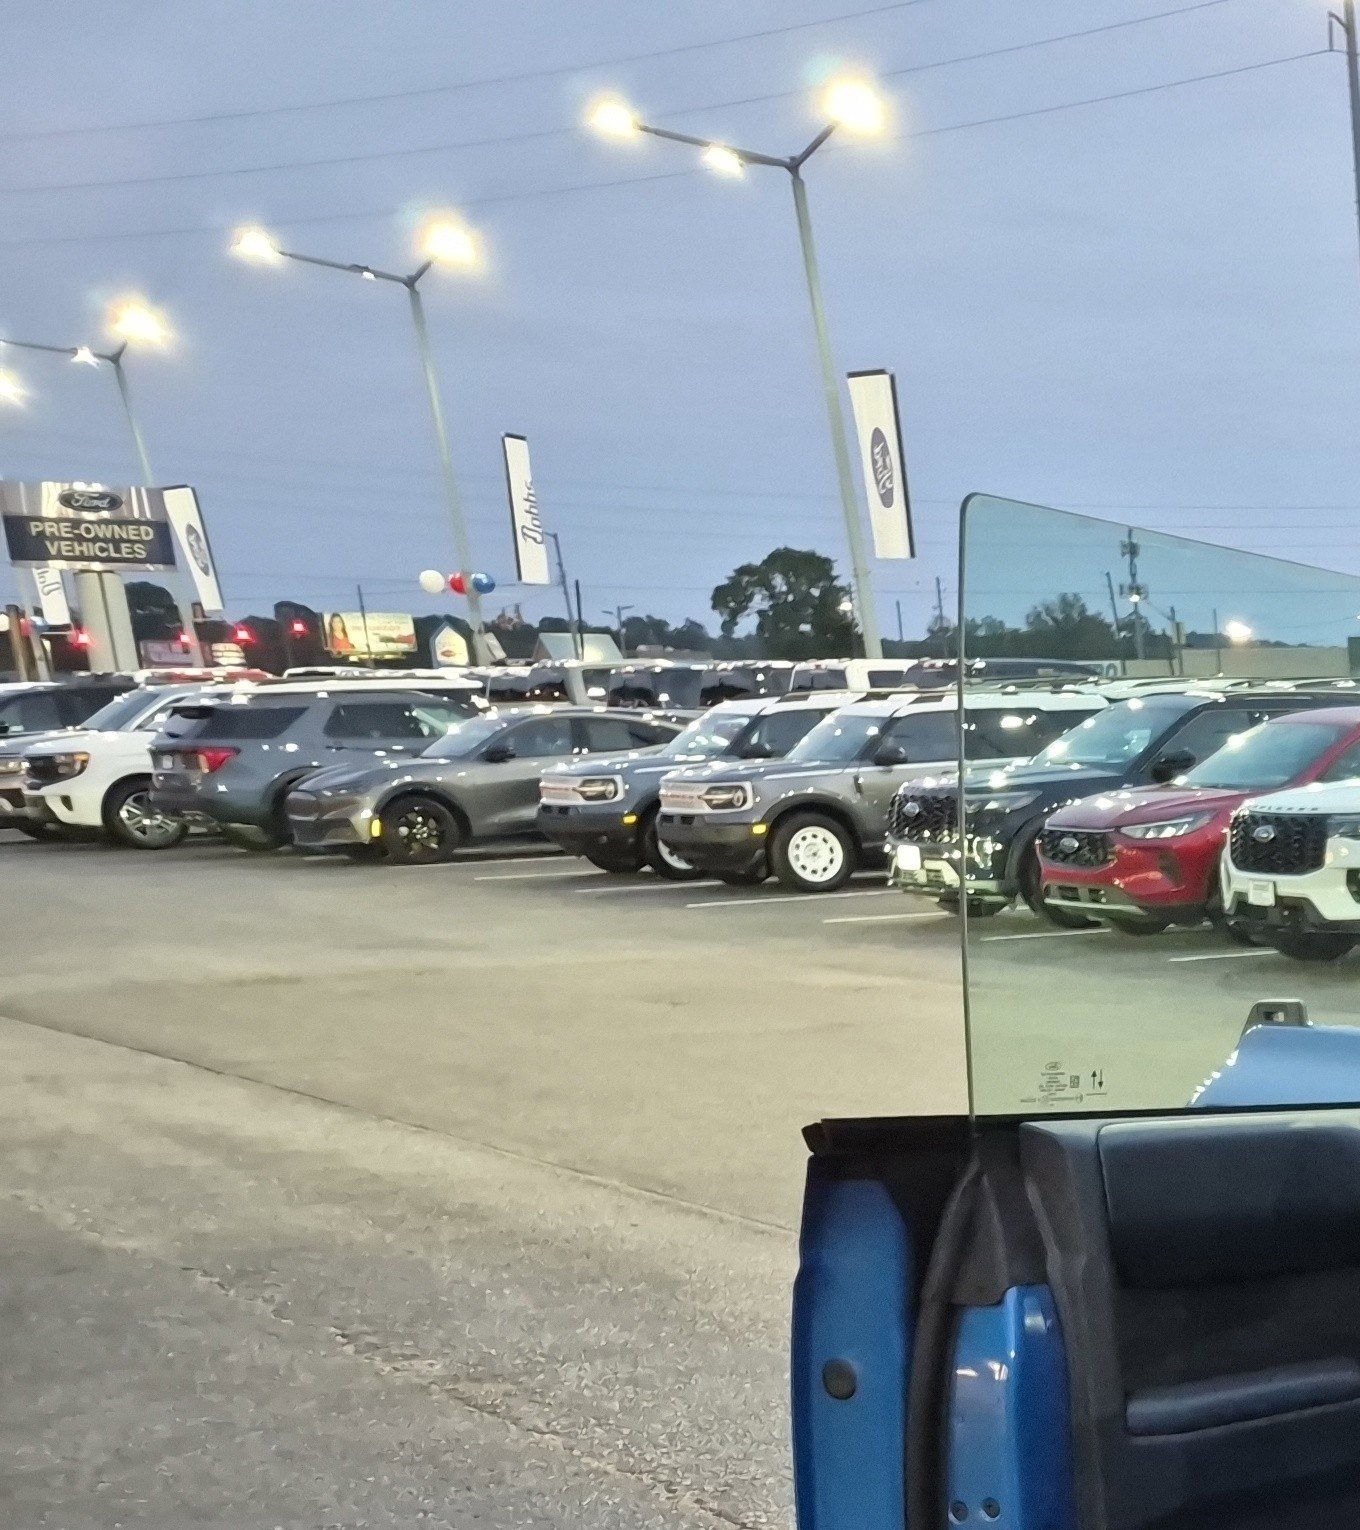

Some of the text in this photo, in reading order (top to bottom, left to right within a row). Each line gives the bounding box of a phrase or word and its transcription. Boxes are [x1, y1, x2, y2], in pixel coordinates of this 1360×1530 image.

[70, 492, 111, 509] Ford
[28, 520, 154, 542] PRE-OWNED
[45, 539, 148, 560] VEHICLES
